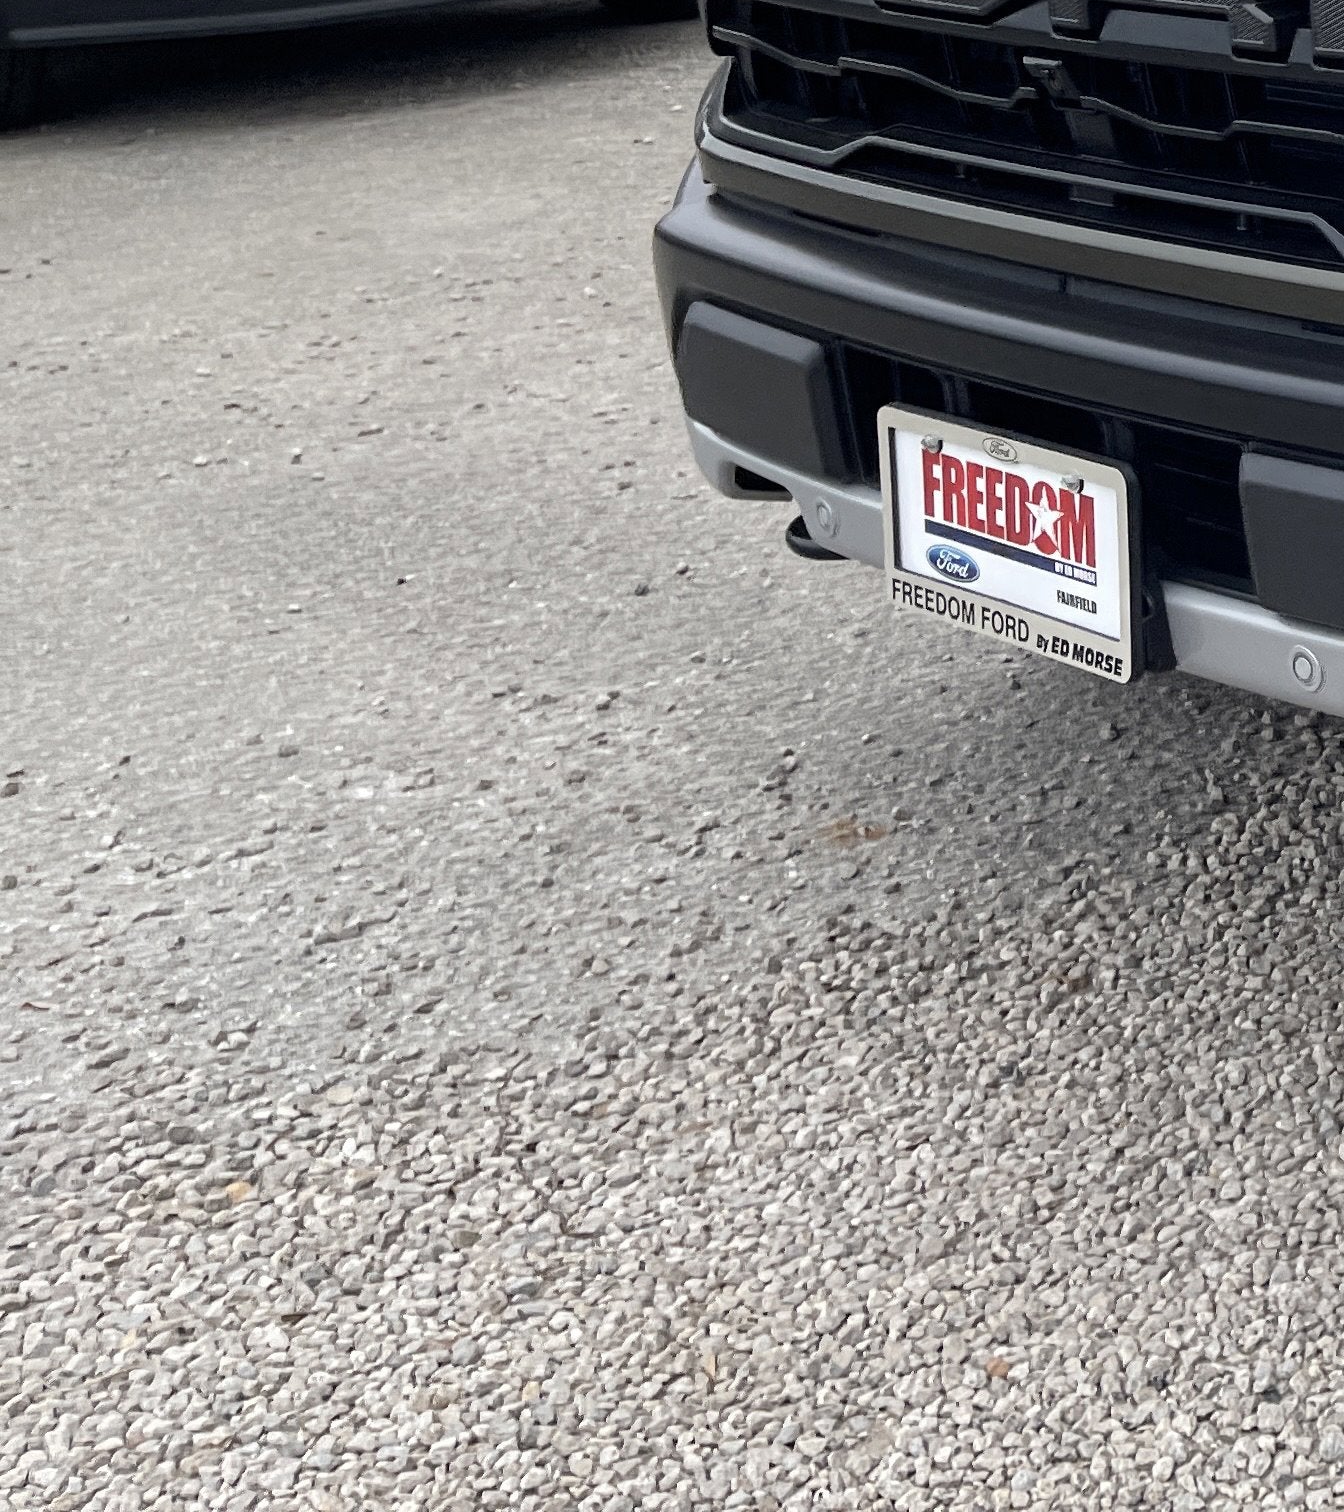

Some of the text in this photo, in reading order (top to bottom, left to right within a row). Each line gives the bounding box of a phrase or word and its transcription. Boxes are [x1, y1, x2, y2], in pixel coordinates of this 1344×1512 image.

[921, 447, 1097, 569] FREEDOM
[936, 549, 970, 578] Ford
[892, 578, 975, 626] FREEDOM
[981, 606, 1030, 643] FORD
[1051, 635, 1070, 658] ED
[1072, 642, 1124, 678] MORSE
[1056, 589, 1097, 615] FAIRFIELD
